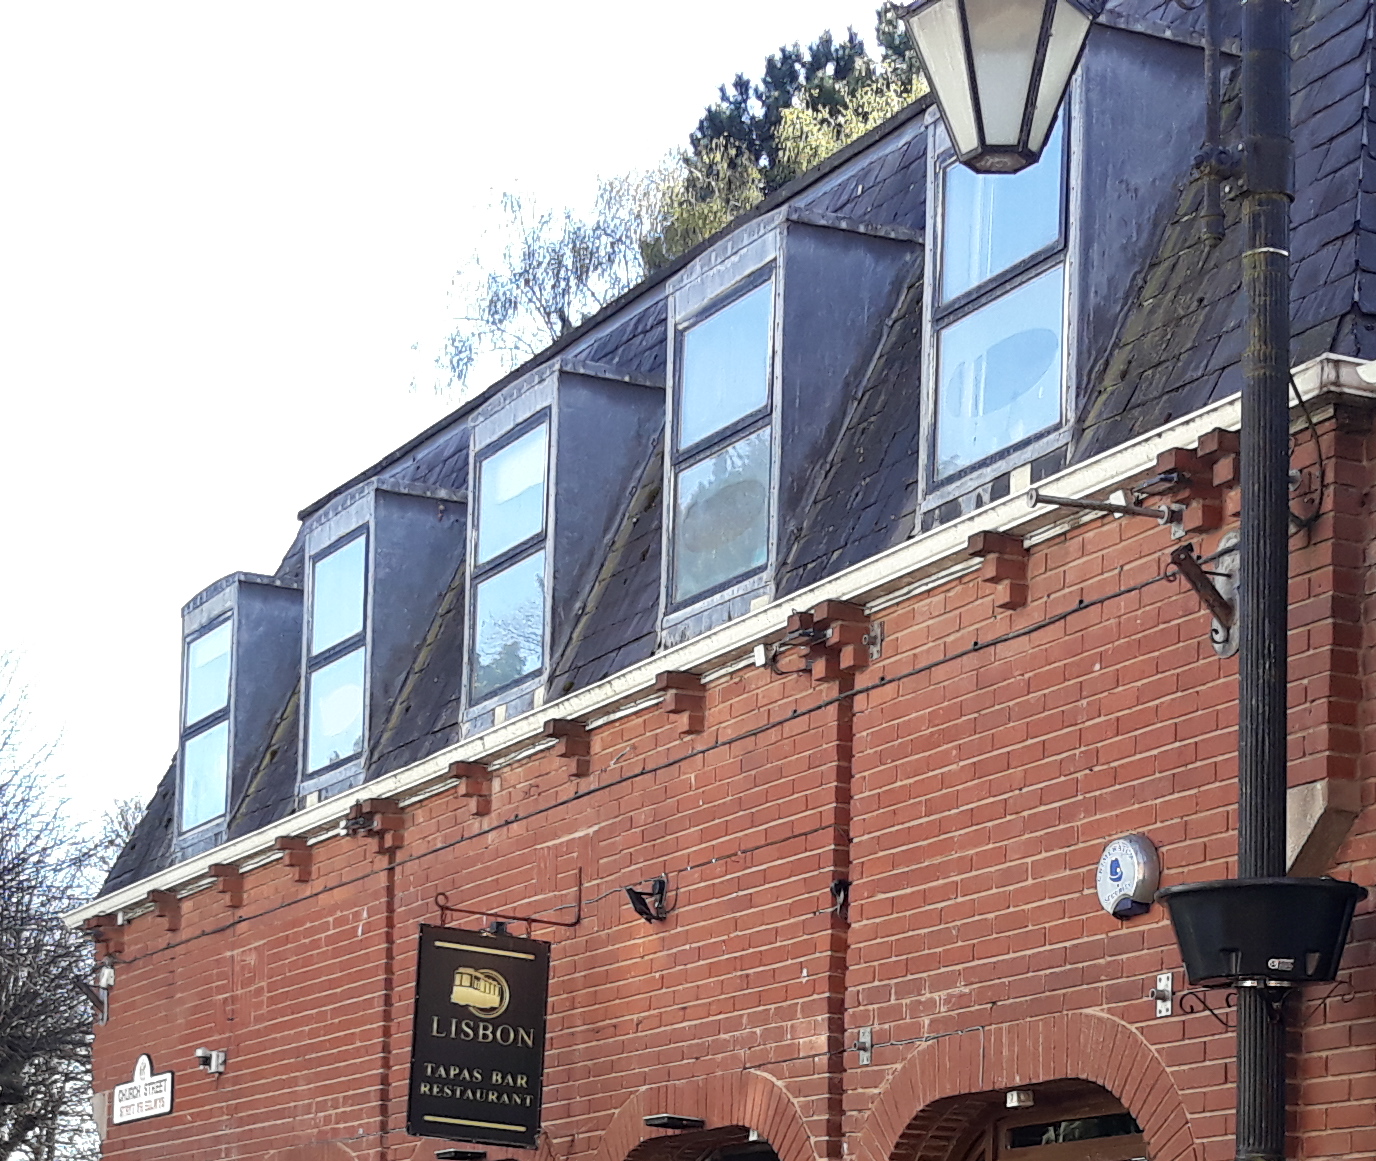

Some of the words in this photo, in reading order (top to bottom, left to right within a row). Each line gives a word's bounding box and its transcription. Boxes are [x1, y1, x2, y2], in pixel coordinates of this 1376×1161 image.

[431, 1015, 535, 1048] LISBON
[424, 1062, 483, 1083] TAPAS
[491, 1070, 528, 1089] BAR
[118, 1085, 141, 1103] CHURCH
[144, 1078, 167, 1096] STREET
[419, 1082, 534, 1107] RESTAURANT
